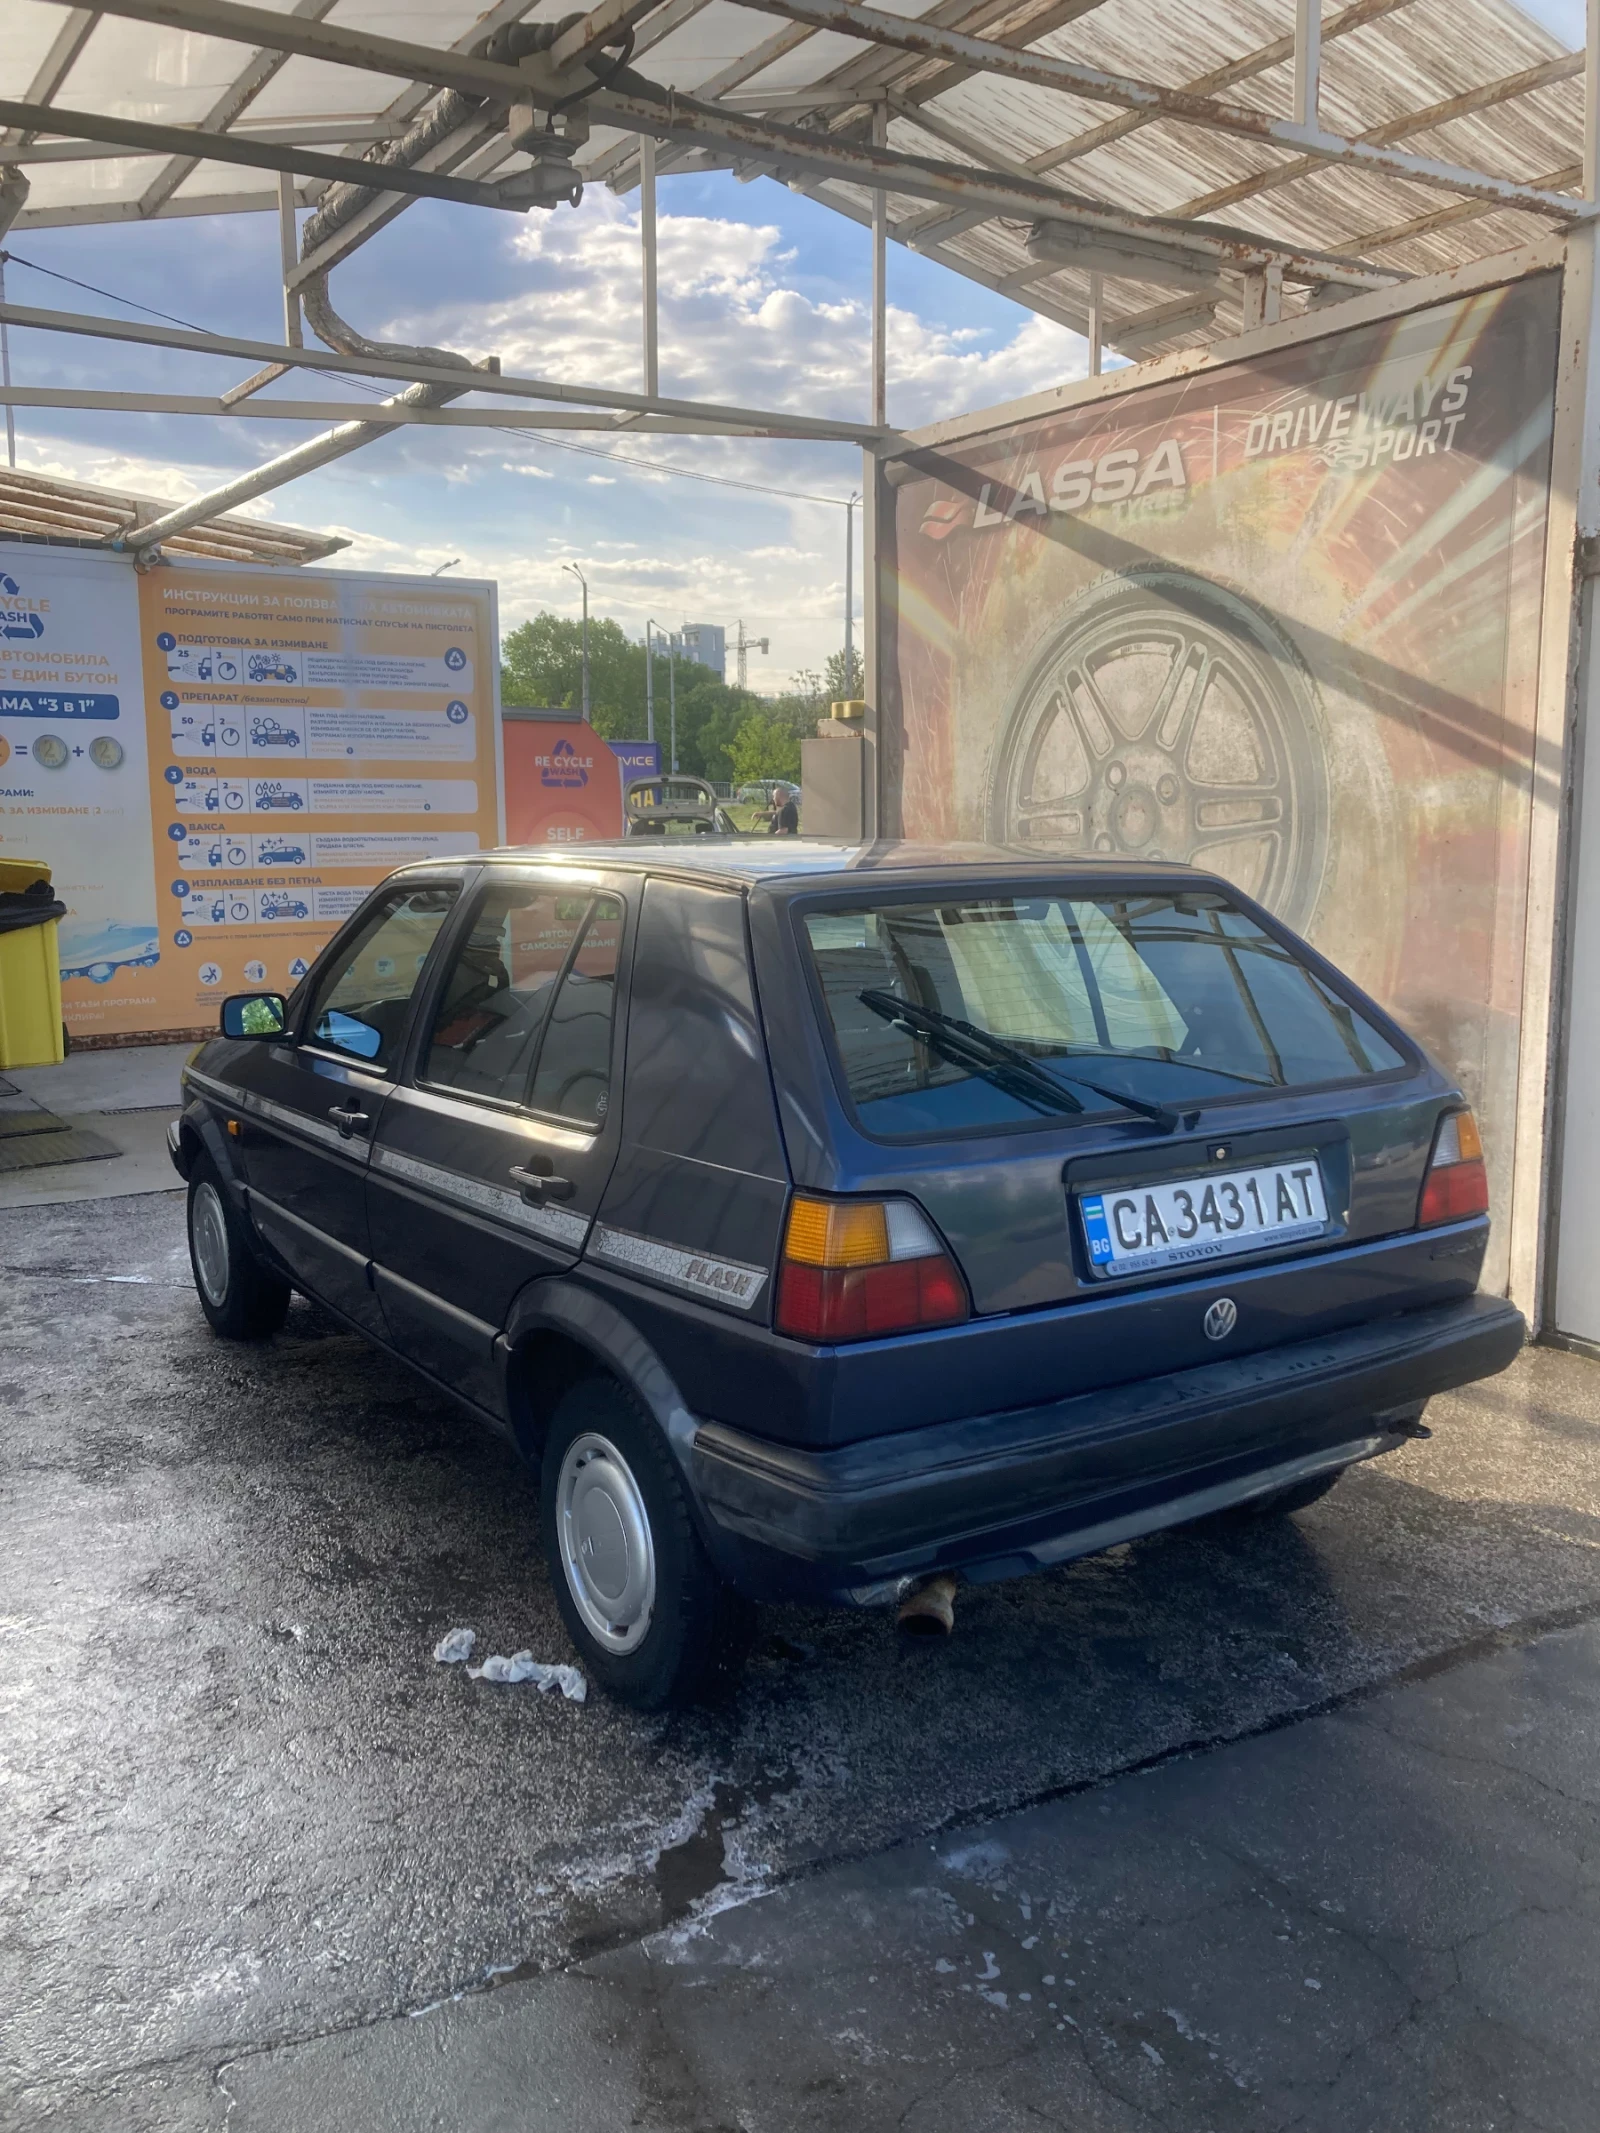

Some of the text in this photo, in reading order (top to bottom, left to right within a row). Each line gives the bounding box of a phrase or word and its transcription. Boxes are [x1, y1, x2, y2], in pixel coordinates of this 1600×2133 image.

[1244, 366, 1472, 457] DRIVEWAYS
[1352, 414, 1467, 471] SPORT
[973, 439, 1189, 530] LASSA
[163, 588, 259, 605] ИНСТРУКЦИИ
[263, 596, 280, 607] ЗА
[165, 606, 474, 633] ПРОГРАМИТЕ РАБОТЯТ САМО ПРИ НАТИСНАТ СПУСЪК НА ПИСТОЛЕТА
[163, 638, 170, 647] 1
[178, 634, 329, 650] ПОДГОТОВКА ЗА ИЗМИВАНЕ
[0, 650, 109, 667] ВТОМОБИЛА
[178, 650, 189, 659] 25
[216, 651, 222, 660] 3
[12, 669, 59, 683] ЕДИН
[64, 672, 118, 685] БУТОН
[166, 696, 173, 705] 2
[181, 692, 310, 706] ПРЕПАРАТ /безконтактно/
[181, 716, 194, 725] 50
[219, 717, 225, 726] 2
[535, 755, 594, 768] RE CYCLE
[171, 770, 177, 780] 3
[185, 766, 217, 777] ВОДА
[549, 768, 580, 776] WASH
[184, 782, 197, 790] 25
[222, 781, 229, 790] 2
[9, 807, 24, 815] ЗА
[27, 806, 89, 815] ИЗМИВАНЕ
[174, 827, 180, 836] 4
[188, 823, 226, 832] ВАКСА
[547, 828, 585, 842] SELF
[188, 838, 200, 847] 50
[226, 838, 232, 846] 2
[191, 876, 322, 890] ИЗПЛАКВАНЕ БЕЗ ПЕТНА
[178, 884, 184, 894] 5
[191, 894, 203, 903] 50
[229, 893, 234, 902] 1
[75, 1000, 98, 1010] ТАЗИ
[103, 998, 157, 1008] ПРОГРАМА
[1113, 1167, 1314, 1250] CA 3431 AT
[1092, 1238, 1110, 1256] BG
[1168, 1244, 1224, 1263] STOYOV
[685, 1258, 753, 1297] FLASH
